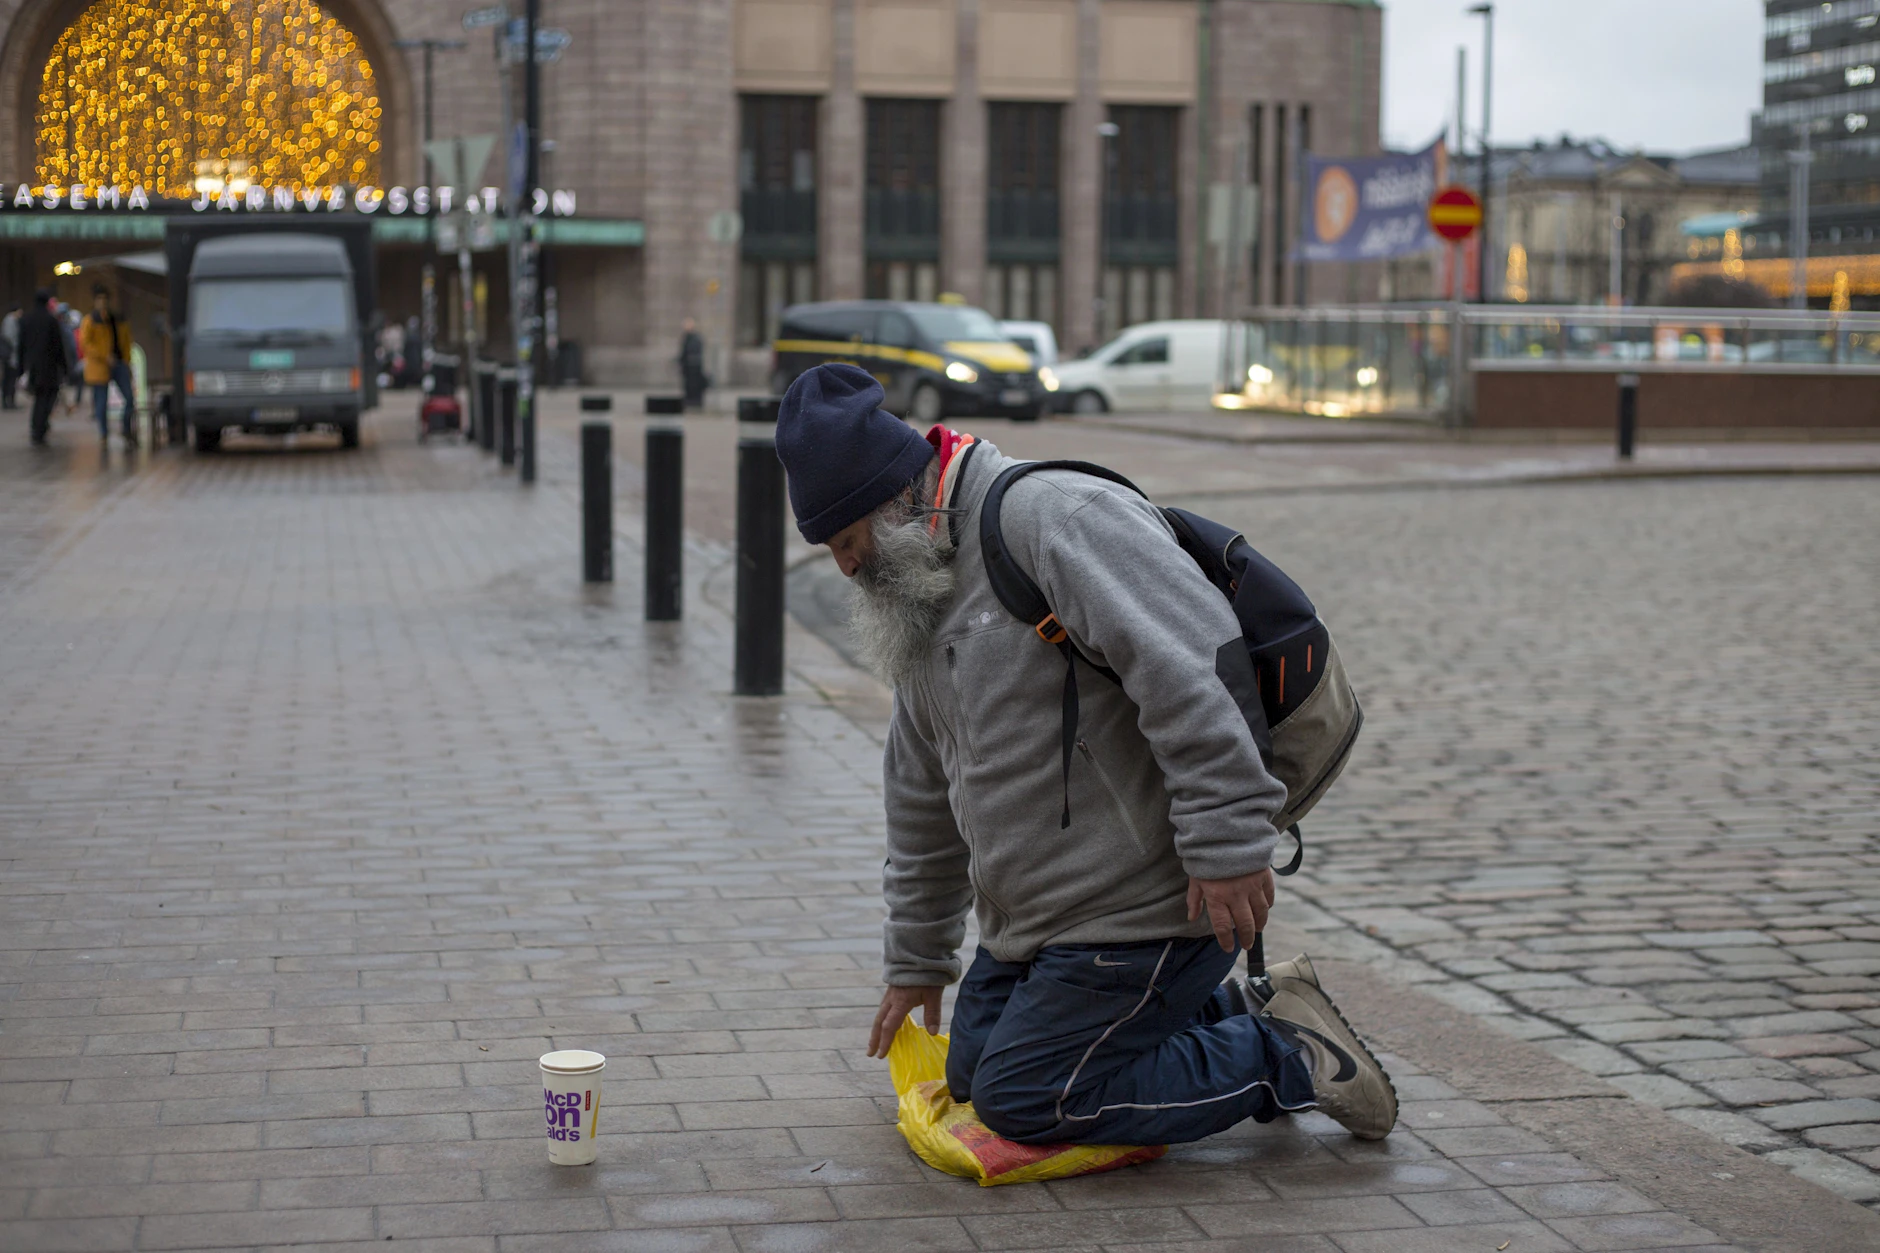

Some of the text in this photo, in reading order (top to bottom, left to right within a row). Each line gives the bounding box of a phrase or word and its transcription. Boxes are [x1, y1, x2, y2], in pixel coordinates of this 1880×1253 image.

[0, 183, 150, 211] ASEMA
[544, 1088, 582, 1107] McD
[547, 1126, 580, 1142] ald's
